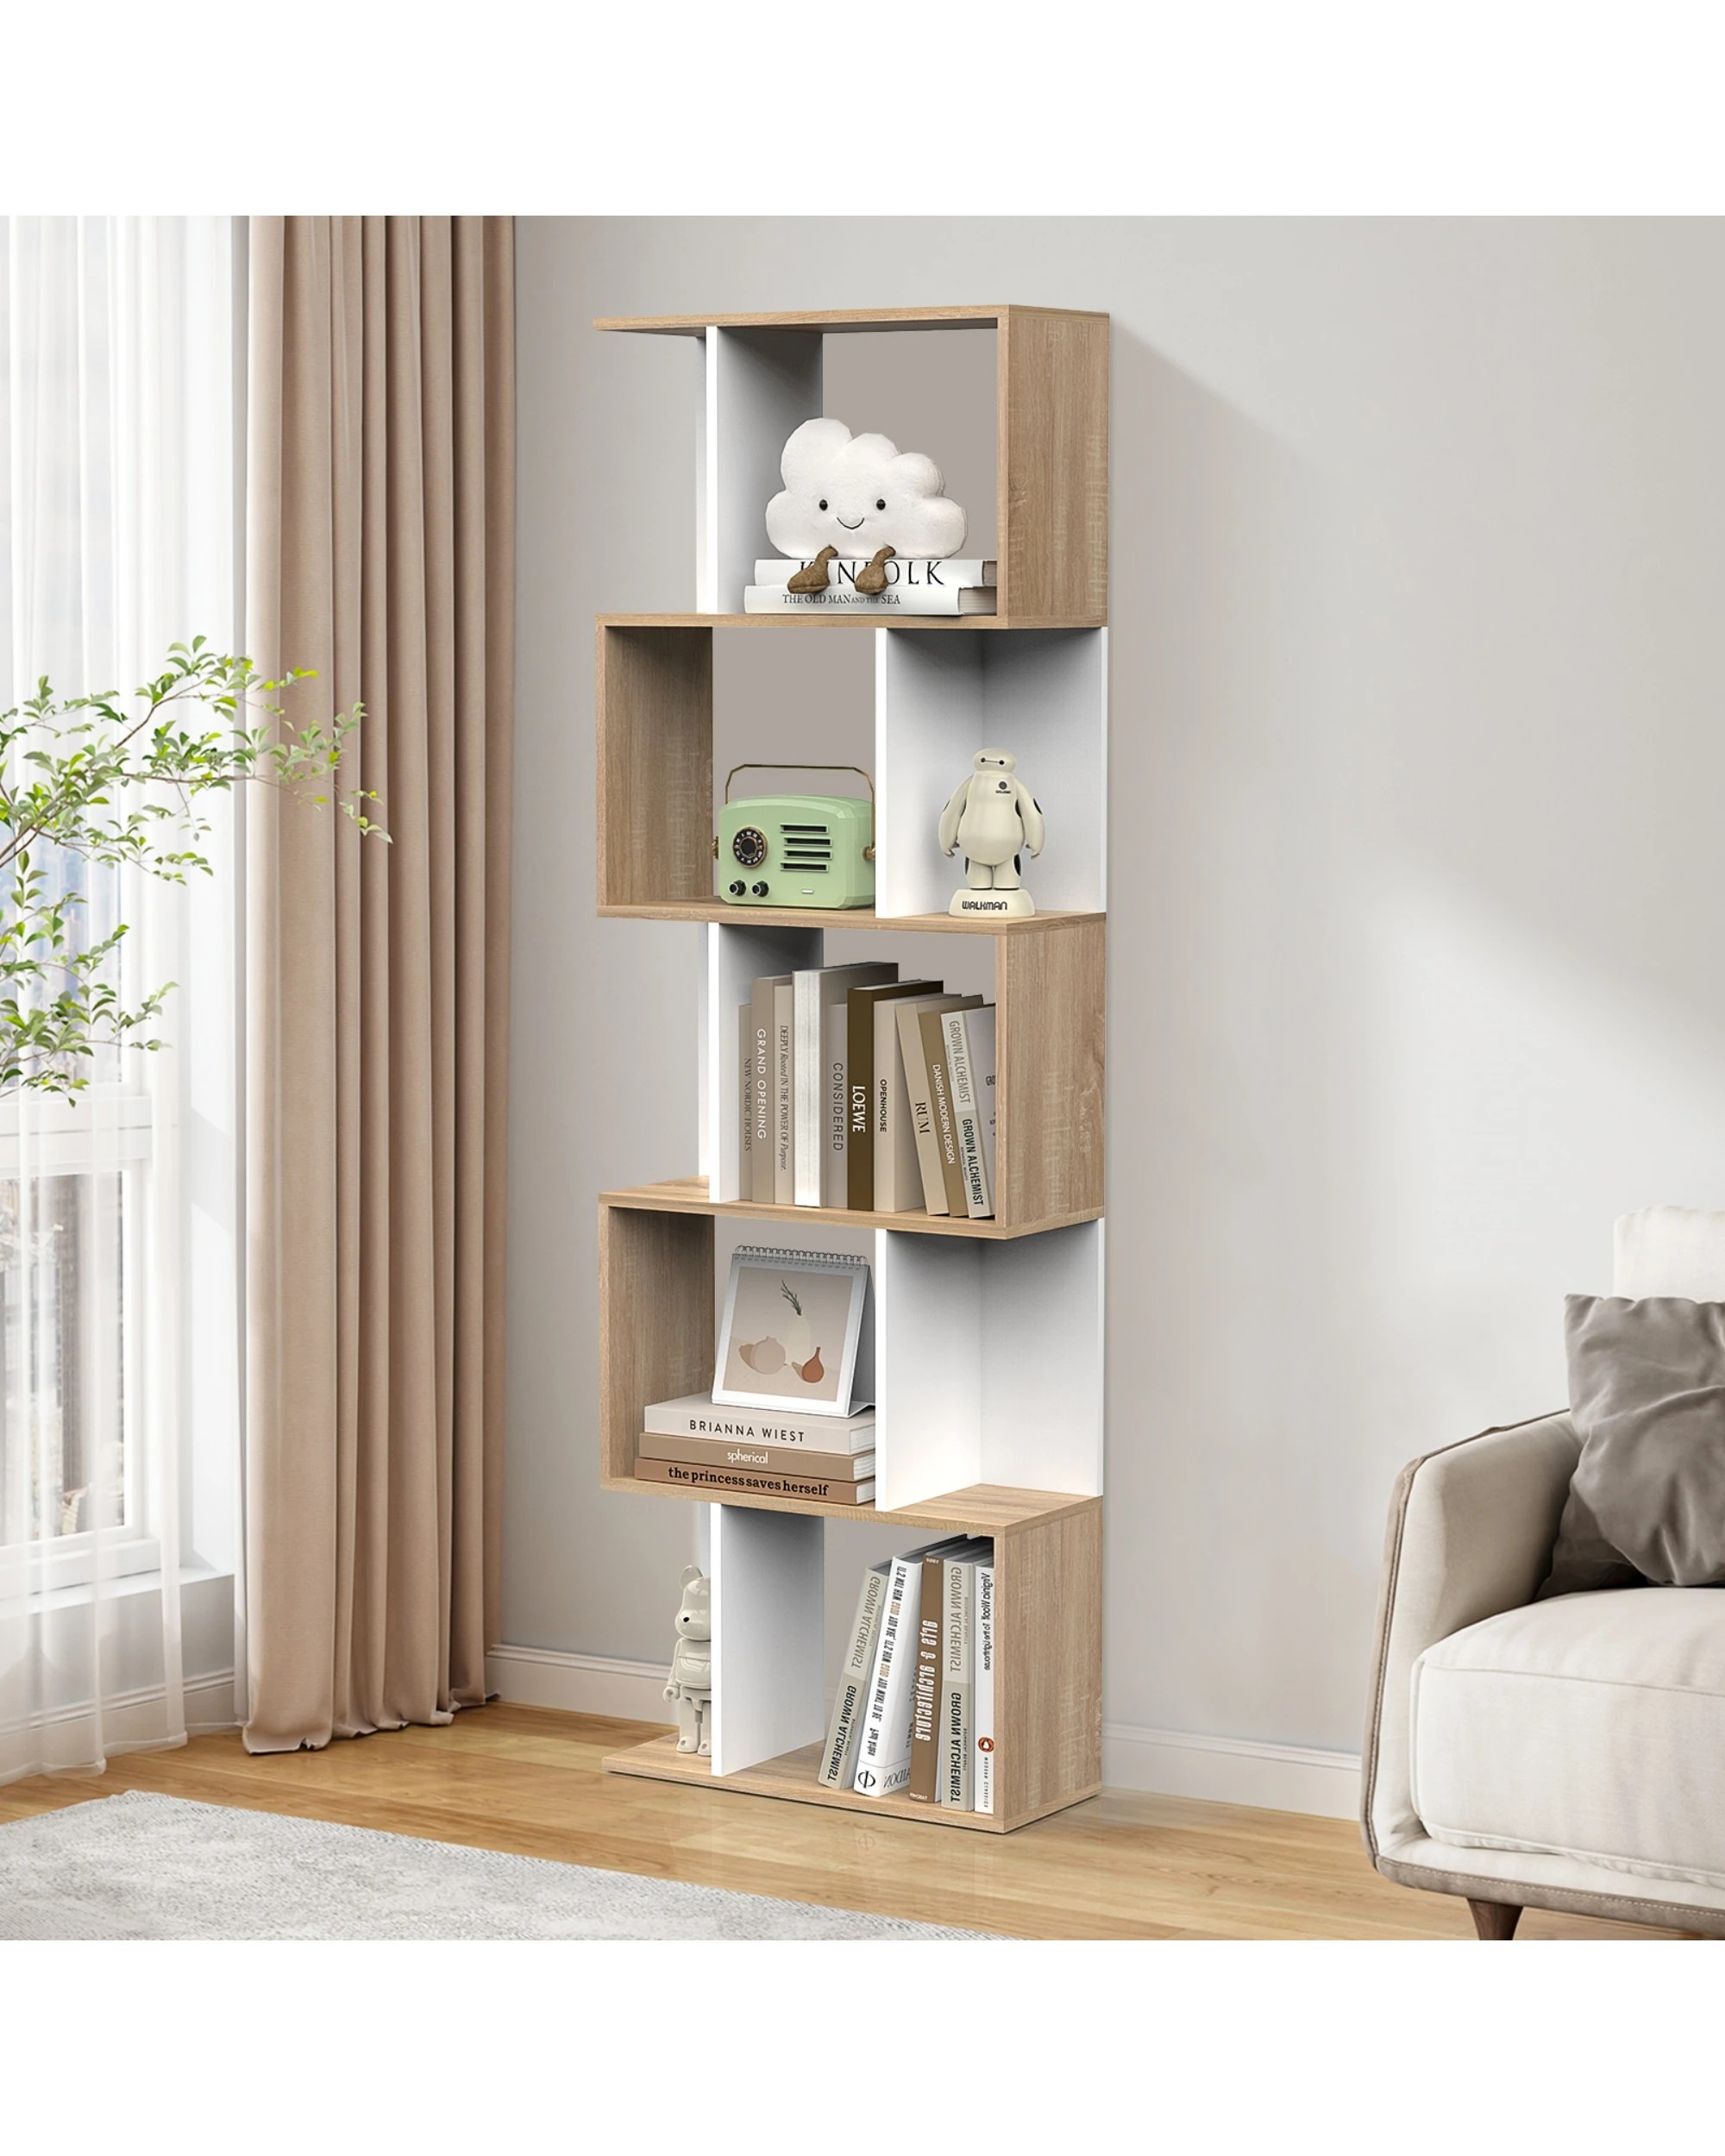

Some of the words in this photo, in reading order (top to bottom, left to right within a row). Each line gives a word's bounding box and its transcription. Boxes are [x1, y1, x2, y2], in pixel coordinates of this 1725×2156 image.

[800, 561, 944, 585] NOLK
[782, 594, 803, 604] THE
[806, 593, 825, 605] OLD
[829, 594, 850, 605] MAN
[881, 594, 900, 605] SEA
[962, 900, 1007, 911] WALKMAN
[780, 1025, 788, 1052] DEEPLY
[949, 1020, 963, 1054] GROWN
[757, 1029, 766, 1075] GRAND
[780, 1053, 788, 1076] Rooted
[780, 1077, 788, 1086] IN
[953, 1056, 971, 1104] ALCHEMIST
[780, 1087, 788, 1102] THE
[833, 1062, 844, 1151] CONSIDERED
[757, 1080, 766, 1139] OPENING
[780, 1104, 788, 1131] POWER
[852, 1086, 866, 1133] LOEWE
[915, 1102, 931, 1134] RUM
[932, 1064, 944, 1095] DANISH
[938, 1096, 950, 1132] MODERN
[944, 1134, 956, 1164] DESIGN
[780, 1131, 788, 1142] OF
[962, 1119, 976, 1153] GROWN
[779, 1144, 788, 1171] Purpose.
[967, 1155, 983, 1206] ALCHEMIST
[690, 1420, 755, 1437] BRIANNA
[762, 1428, 805, 1442] WIEST
[727, 1449, 768, 1464] spherical
[668, 1467, 689, 1480] the
[691, 1470, 745, 1487] princess
[746, 1478, 781, 1490] saves
[783, 1480, 829, 1496] herself
